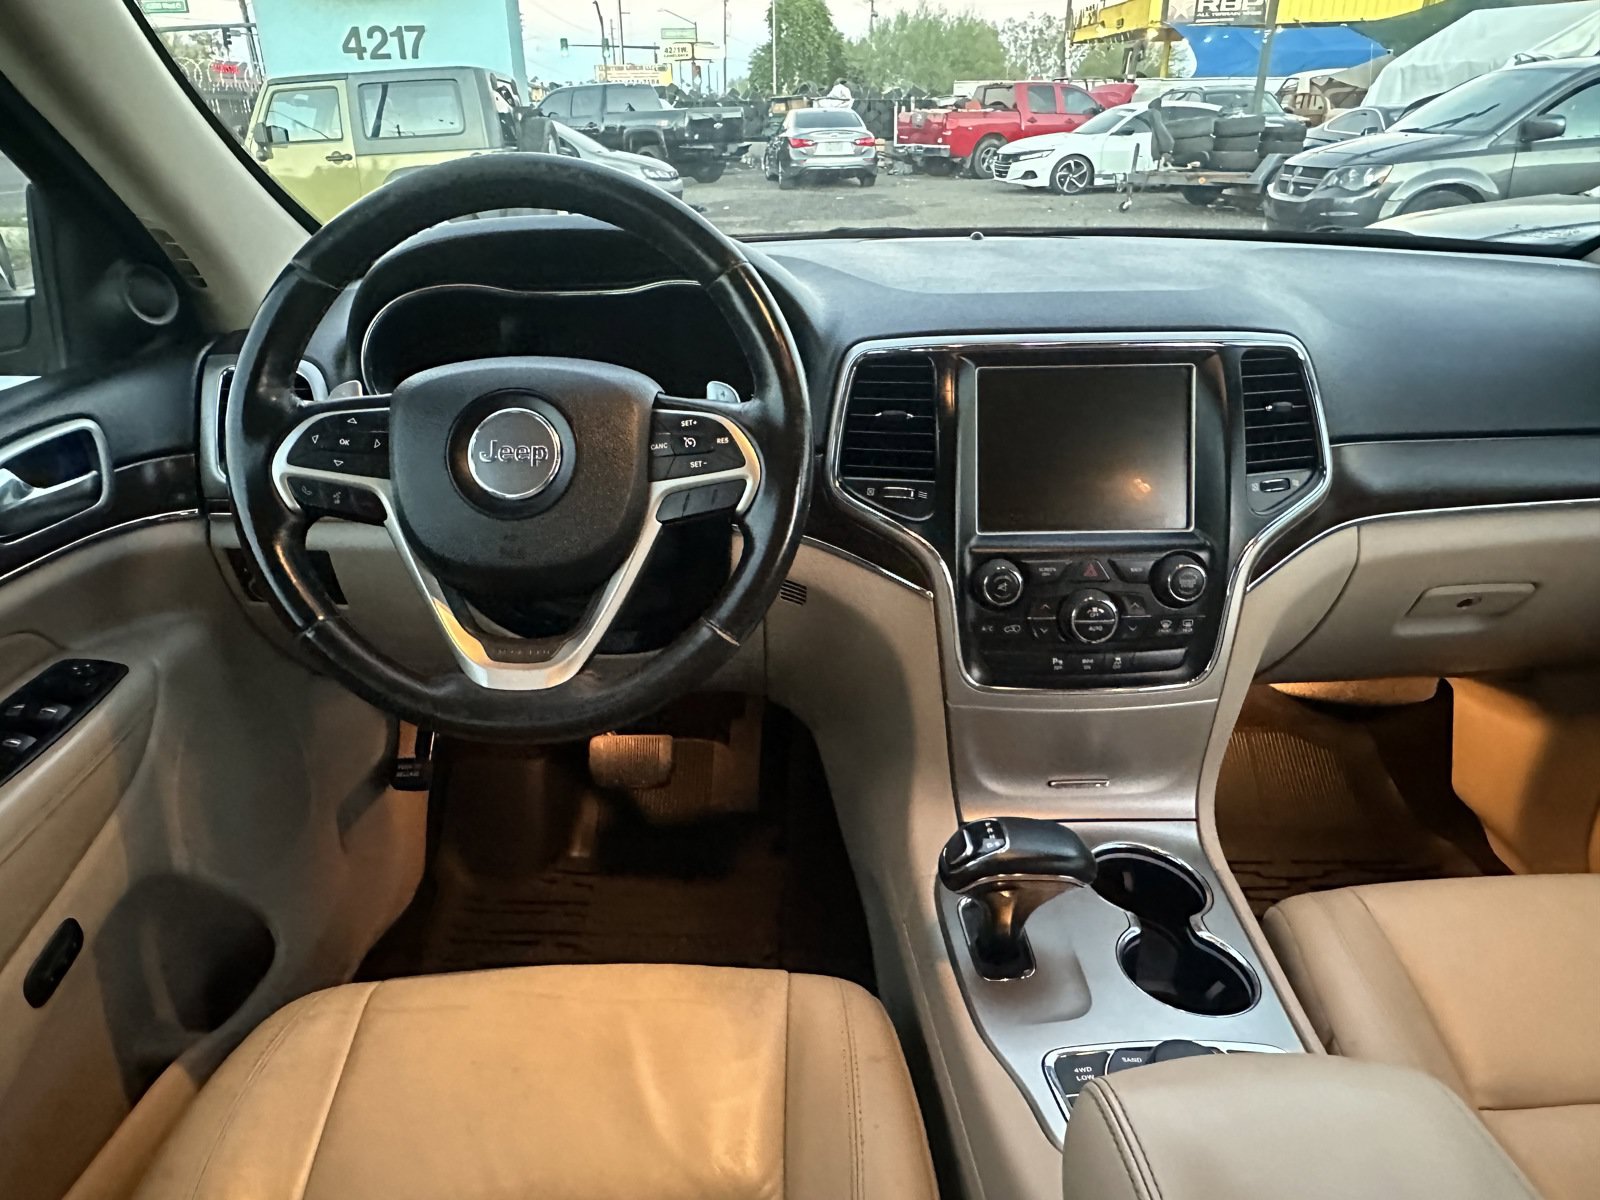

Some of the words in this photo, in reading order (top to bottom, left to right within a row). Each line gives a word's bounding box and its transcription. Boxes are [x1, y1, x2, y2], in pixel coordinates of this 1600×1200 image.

[1197, 0, 1264, 12] RBP
[342, 25, 425, 60] 4217
[339, 438, 350, 446] OK
[479, 440, 549, 467] Jeep
[1076, 1074, 1095, 1082] LOW
